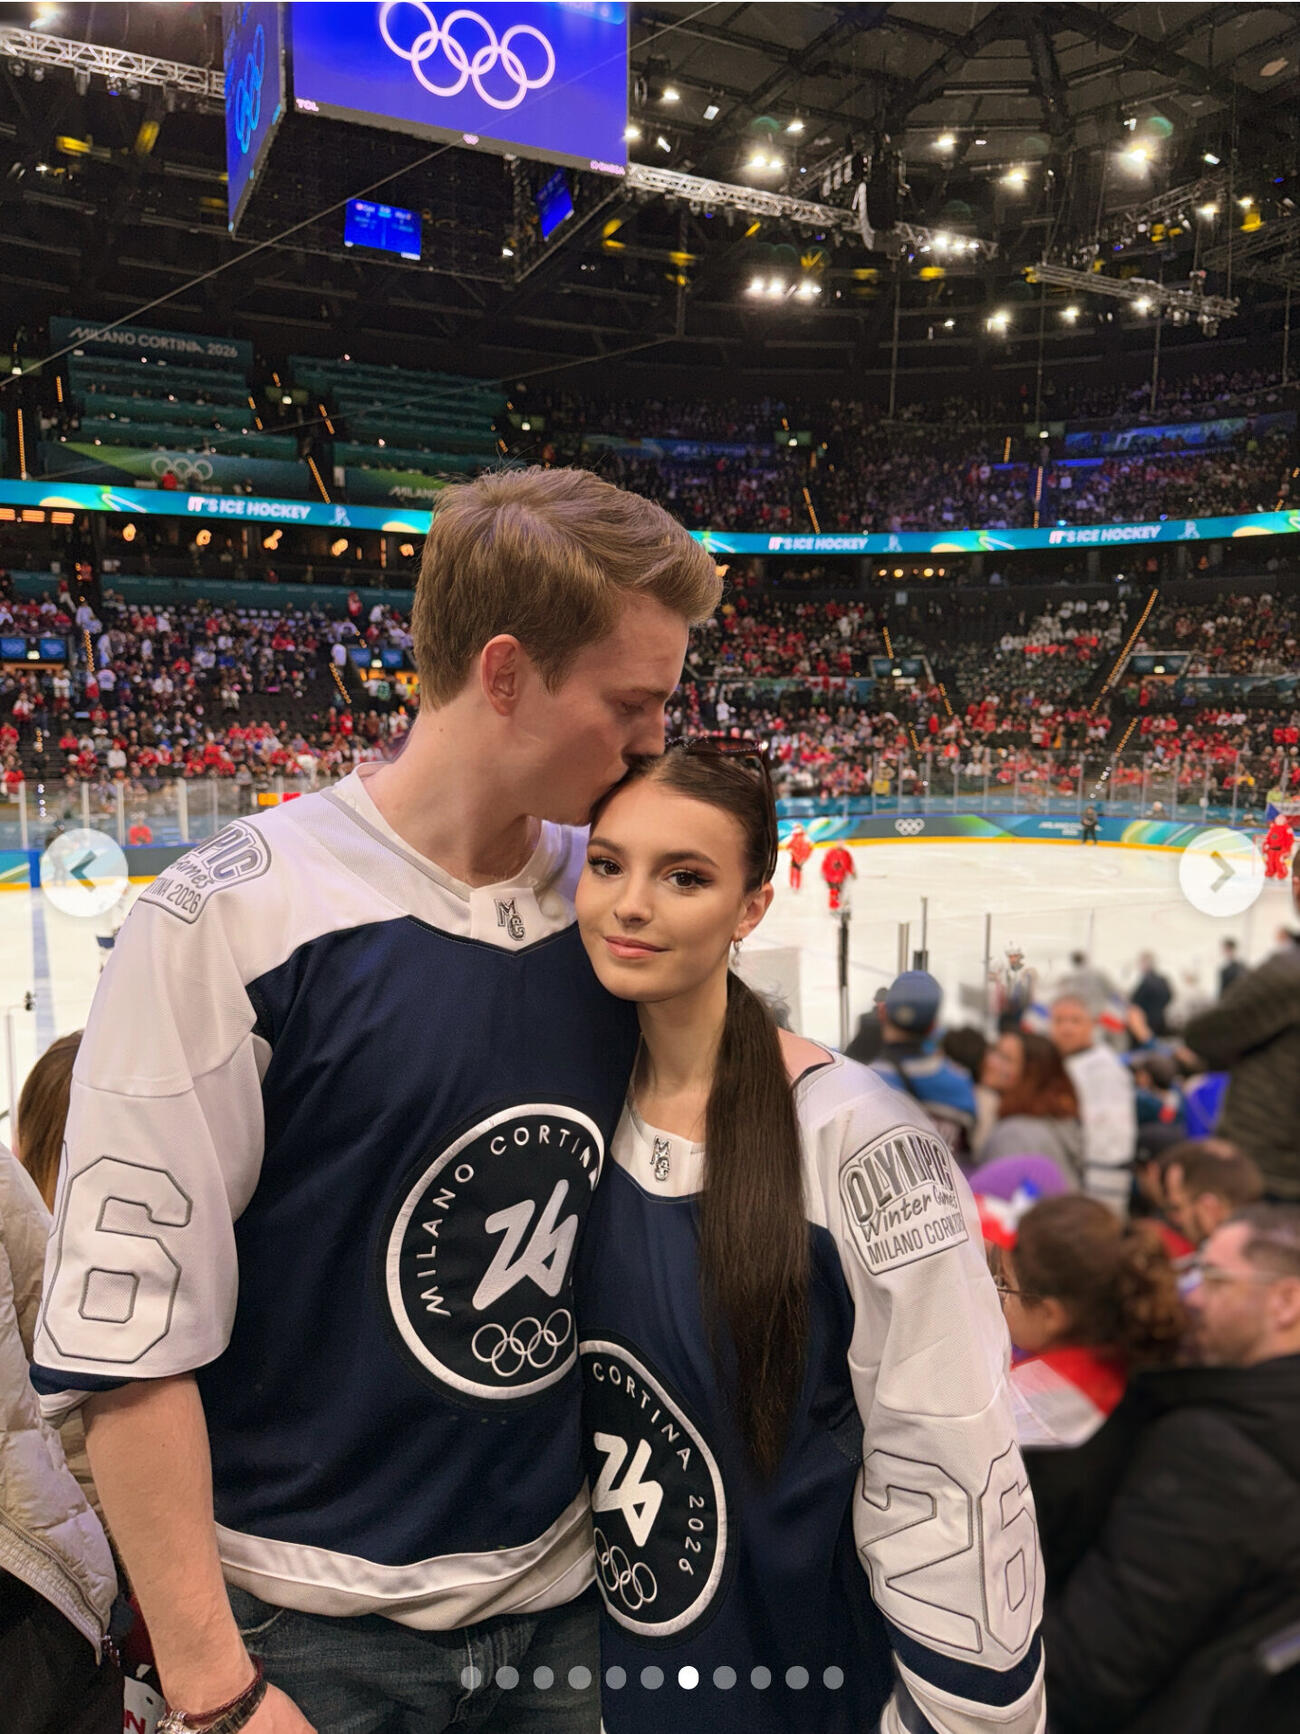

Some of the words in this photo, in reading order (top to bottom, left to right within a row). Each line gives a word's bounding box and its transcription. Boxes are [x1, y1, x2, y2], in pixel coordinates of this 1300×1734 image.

[68, 326, 136, 347] MILANO
[206, 342, 239, 358] 2026
[187, 495, 218, 514] IT'S
[219, 498, 246, 515] ICE
[246, 500, 311, 520] HOCKEY
[792, 536, 815, 550] ICE
[815, 537, 869, 551] HOCKEY
[1077, 528, 1100, 543] ICE
[1101, 525, 1162, 542] HOCKEY
[166, 883, 201, 914] 2026
[860, 1194, 932, 1242] Winter
[416, 1162, 475, 1317] MILANO
[867, 1228, 924, 1266] MILANO
[592, 1361, 692, 1473] CORTINA
[678, 1494, 705, 1577] 2026
